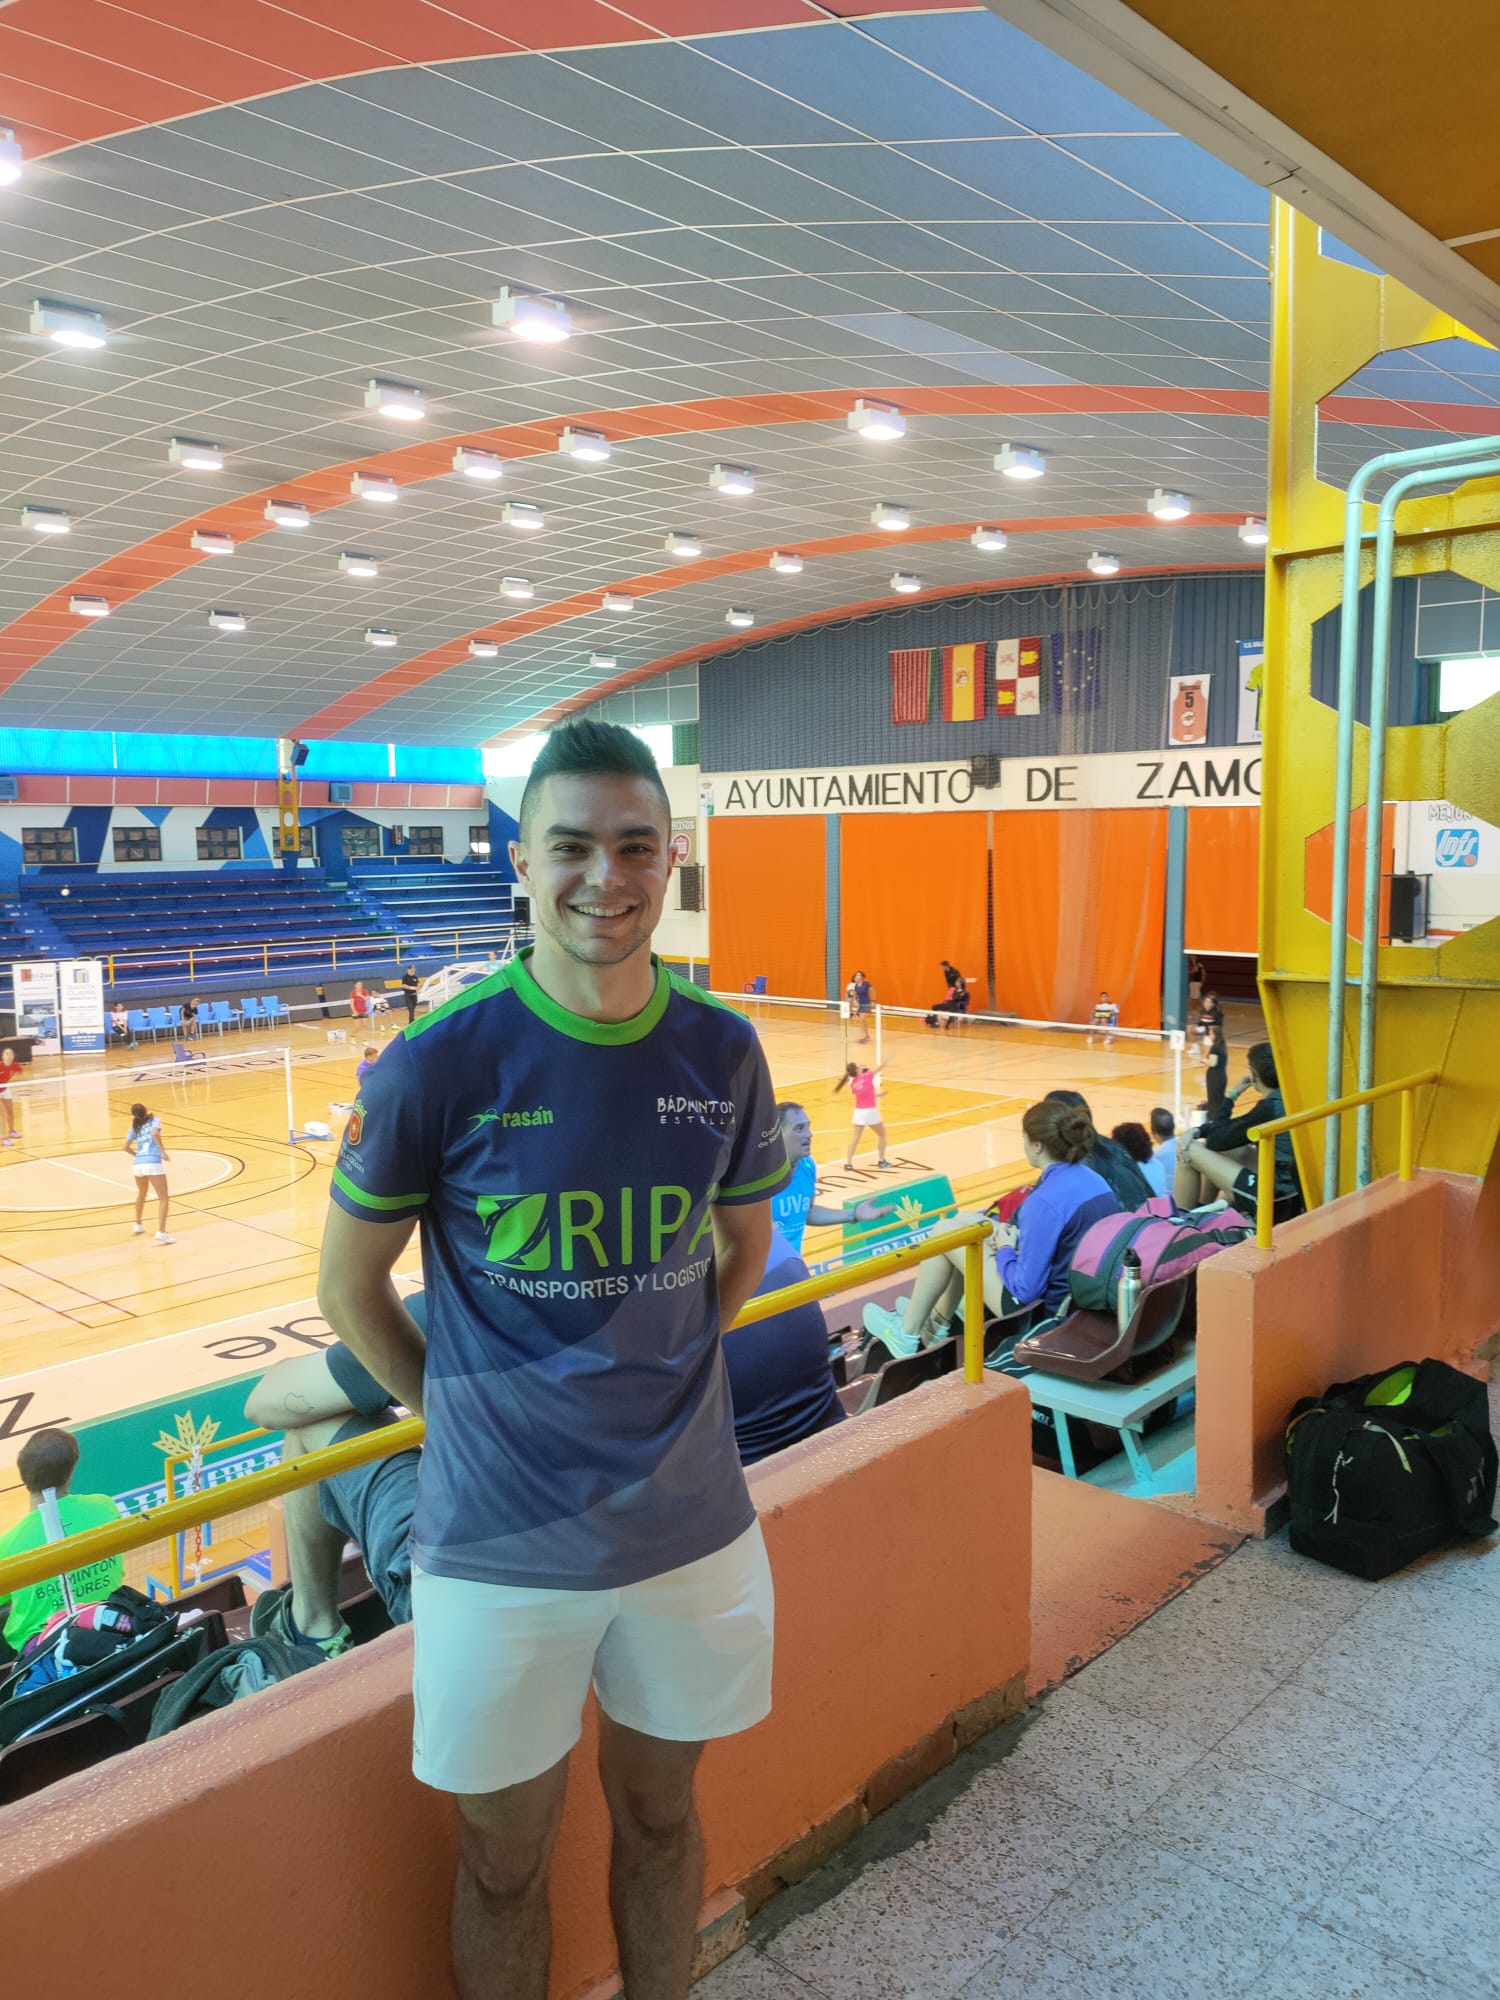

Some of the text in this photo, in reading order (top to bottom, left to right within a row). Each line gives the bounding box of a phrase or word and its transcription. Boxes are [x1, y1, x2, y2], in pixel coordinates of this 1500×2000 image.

[1184, 691, 1194, 708] 5
[725, 768, 975, 810] AYUNTAMIENTO
[1026, 766, 1078, 802] DE
[502, 1105, 554, 1128] rasán
[779, 1193, 810, 1217] UVa
[483, 1270, 630, 1300] TRANSPORTES
[633, 1274, 648, 1292] Y
